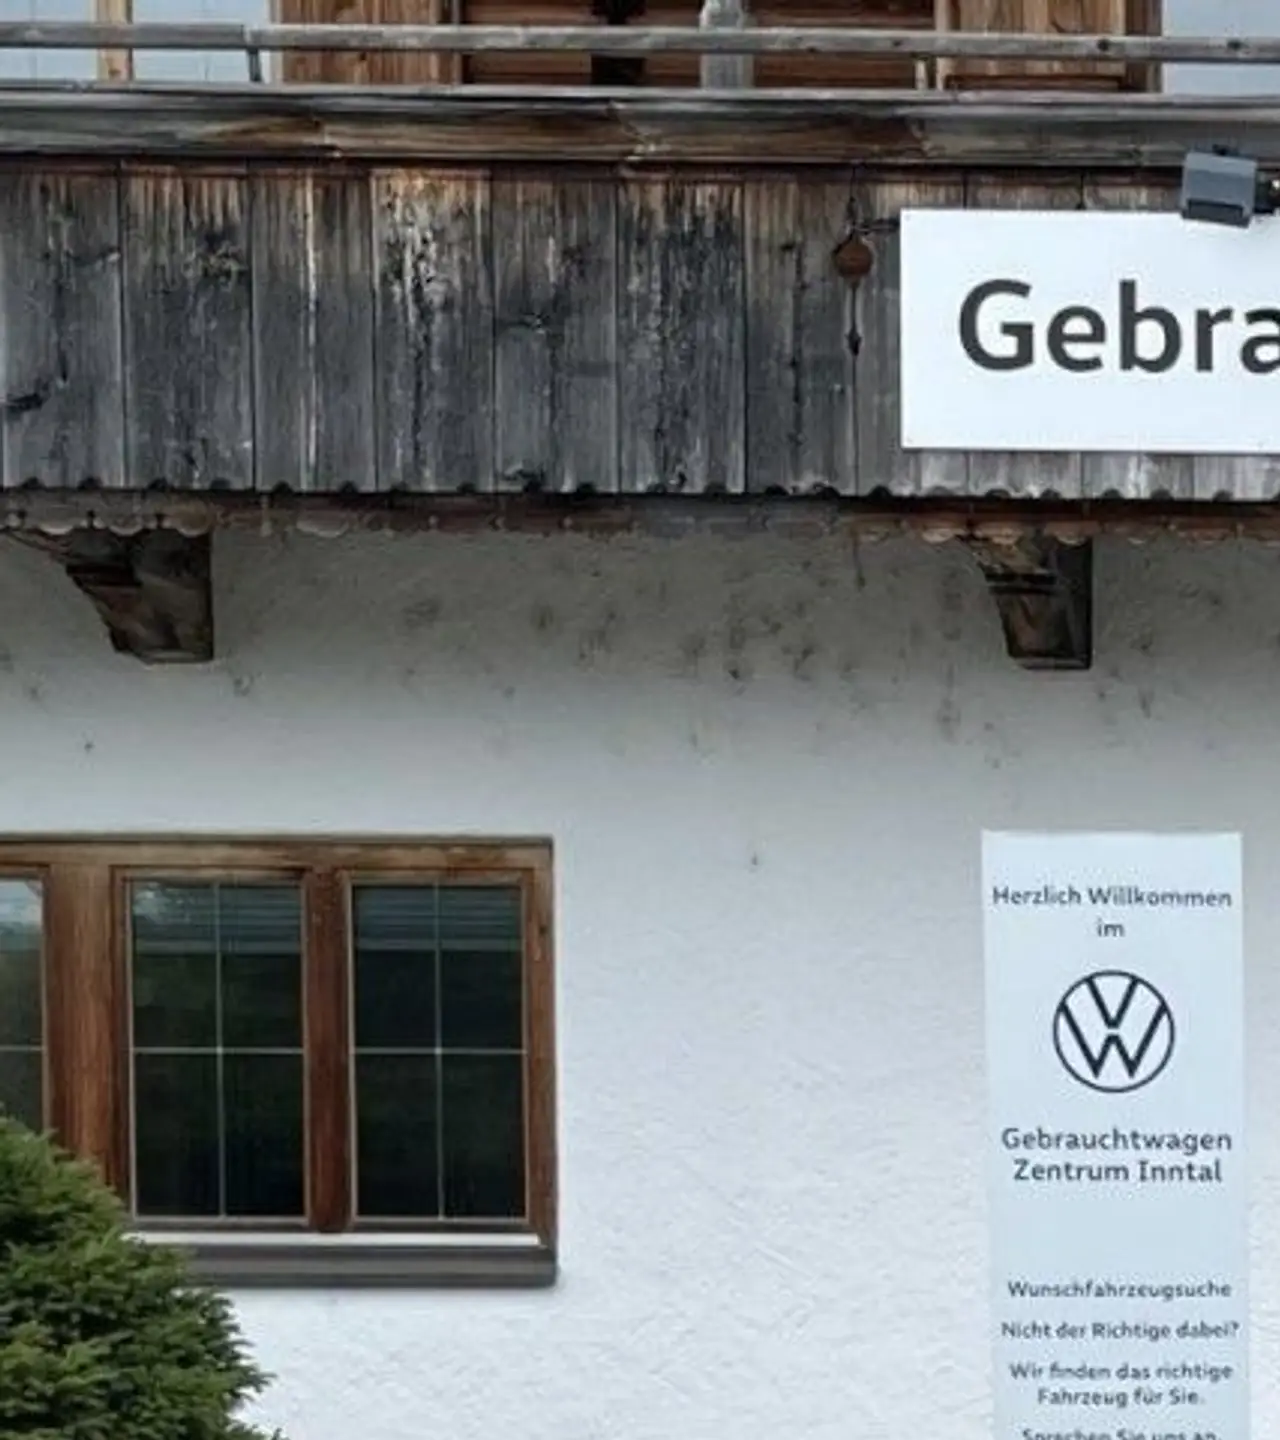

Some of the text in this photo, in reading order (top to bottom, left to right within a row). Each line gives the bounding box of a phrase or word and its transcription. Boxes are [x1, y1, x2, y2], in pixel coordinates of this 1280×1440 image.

[992, 885, 1233, 907] Herzlich Willkommen
[1096, 918, 1126, 938] im
[1001, 1126, 1233, 1156] Gebrauchtwagen
[1012, 1157, 1223, 1183] Zentrum Inntal
[1007, 1280, 1232, 1302] Wunschfahrzeugsuche
[1001, 1319, 1240, 1342] Nicht der Richtige dabei?
[1009, 1361, 1234, 1383] Wir finden das richtige
[1036, 1386, 1206, 1408] Fahrzeug für Sie.
